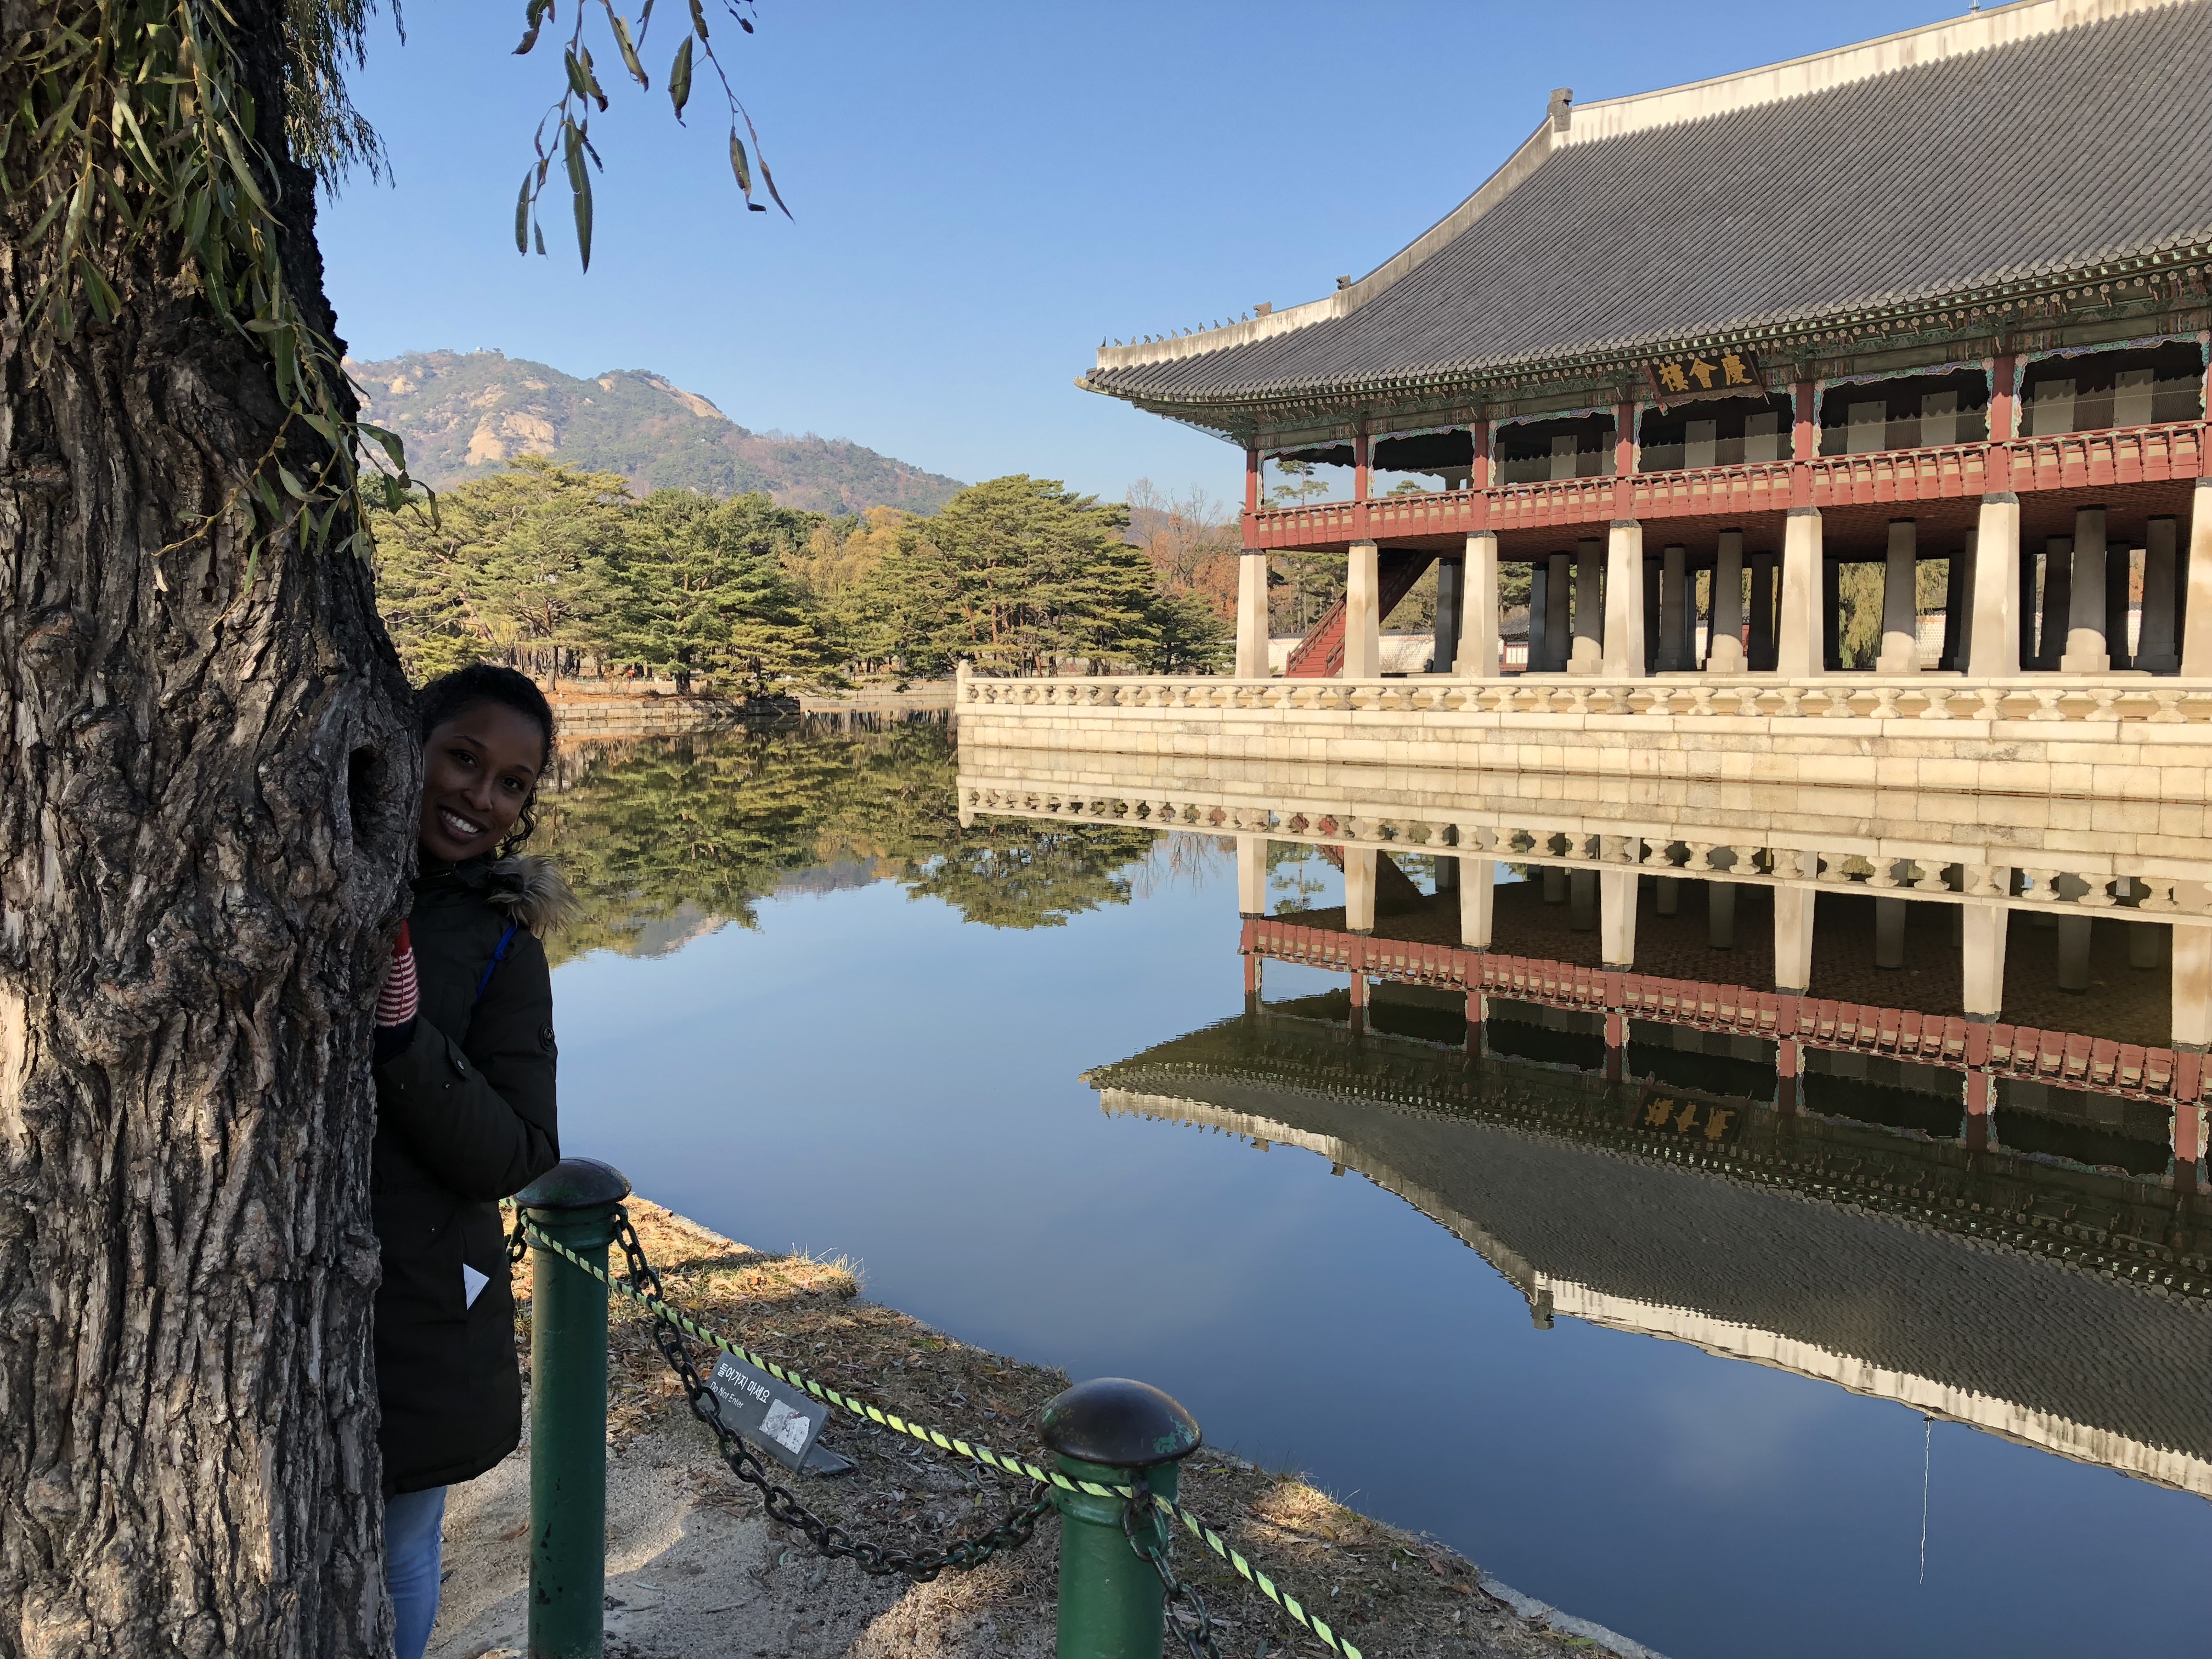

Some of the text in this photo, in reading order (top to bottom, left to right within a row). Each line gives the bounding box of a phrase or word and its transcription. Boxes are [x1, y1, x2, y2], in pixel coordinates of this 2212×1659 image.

[710, 1381, 744, 1409] Do Not Enter
[717, 1362, 770, 1404] 들어가지 마세요
